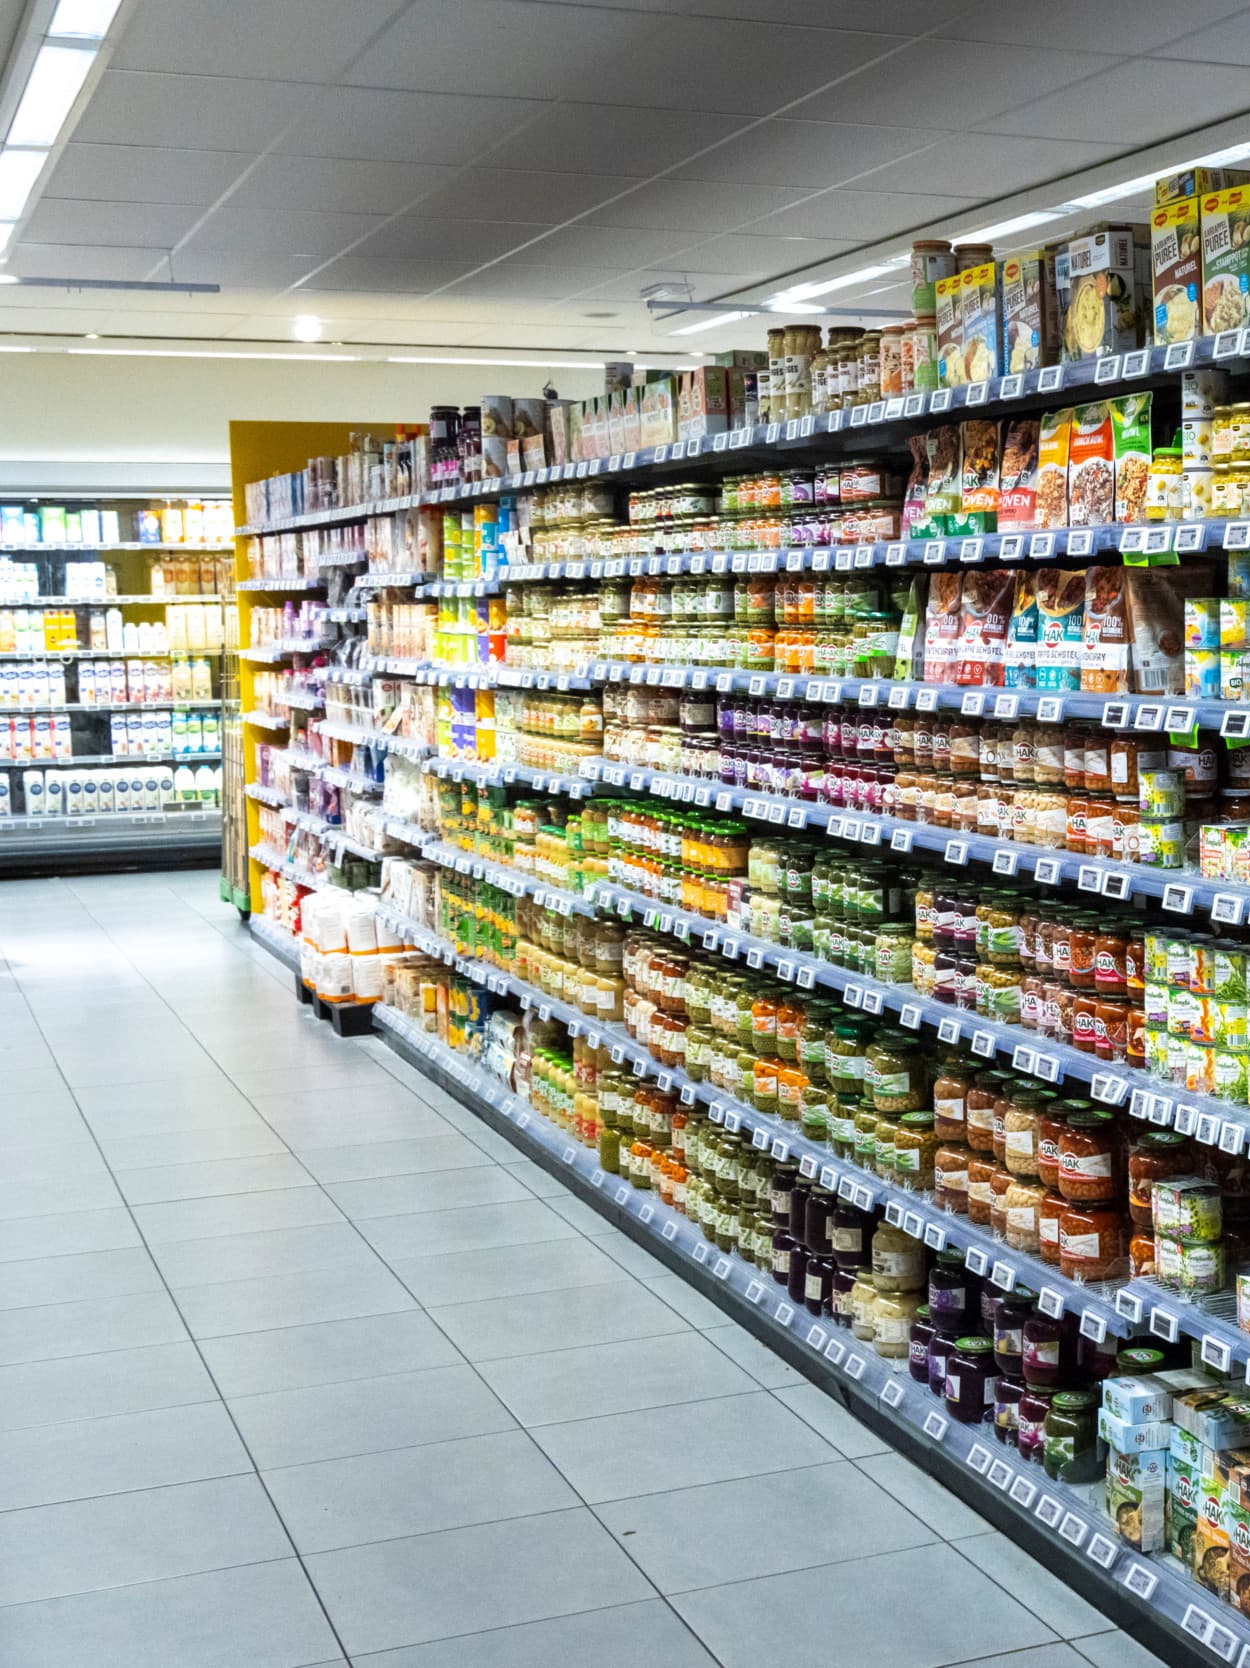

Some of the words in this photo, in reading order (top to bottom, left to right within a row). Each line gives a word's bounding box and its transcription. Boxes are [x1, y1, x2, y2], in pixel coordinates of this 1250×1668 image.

[1205, 230, 1230, 253] PUREE
[1071, 248, 1092, 270] NATUREL
[1155, 243, 1178, 267] PUREE
[1174, 262, 1198, 279] NATUREL
[963, 494, 994, 508] OVEN
[1002, 495, 1030, 508] OVEN
[1044, 628, 1063, 642] HAK
[1040, 1143, 1058, 1157] HAK
[1061, 1155, 1080, 1171] HAK
[1116, 1459, 1135, 1480] HAK
[1176, 1482, 1196, 1500] HAK
[1205, 1505, 1224, 1524] HAK
